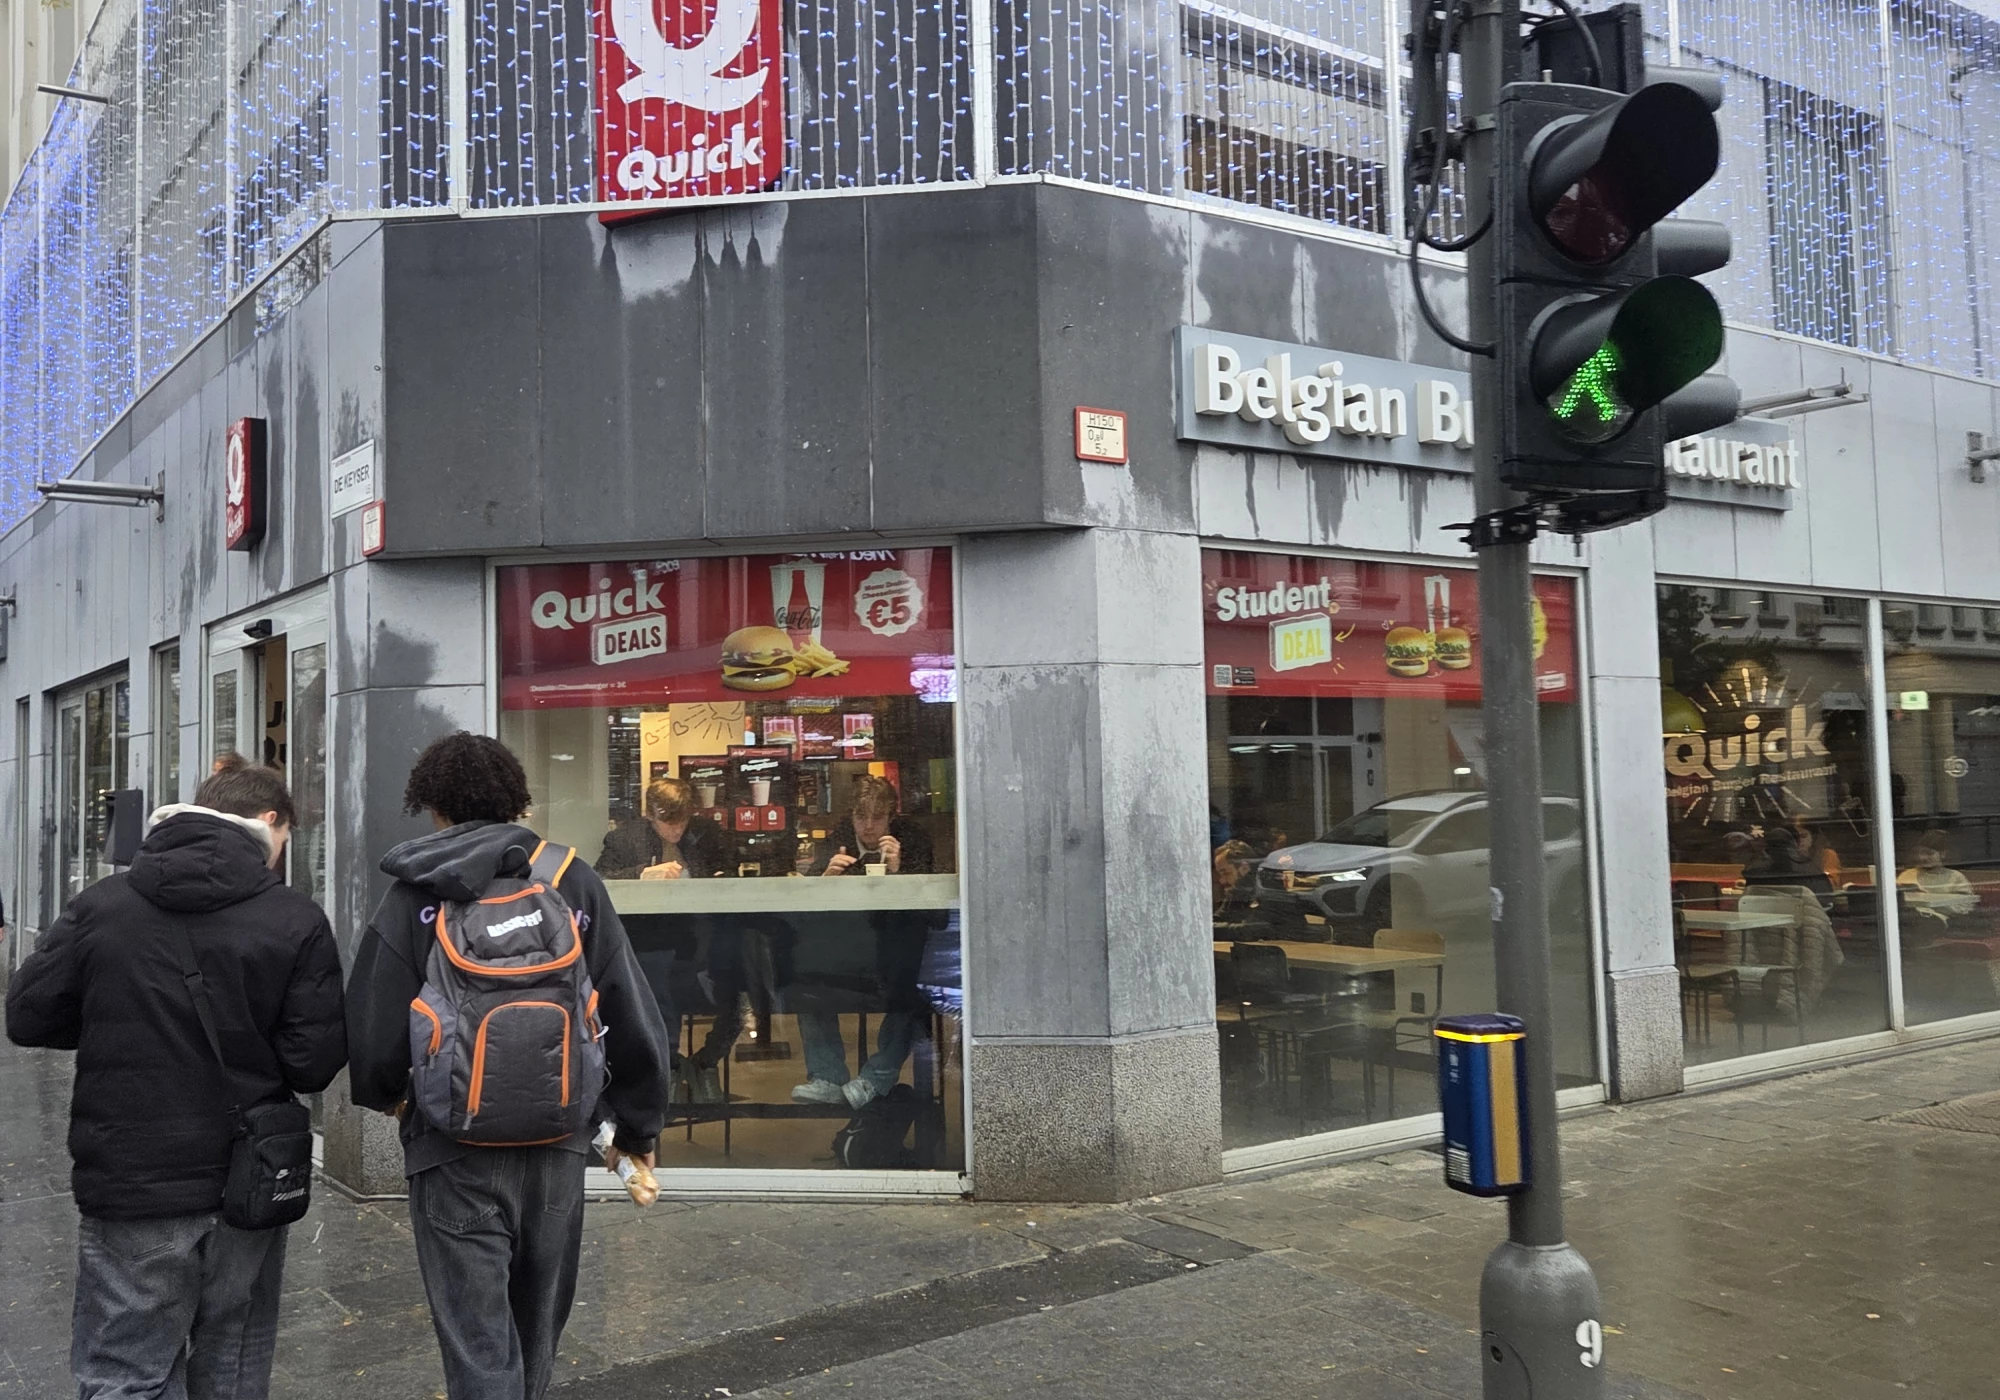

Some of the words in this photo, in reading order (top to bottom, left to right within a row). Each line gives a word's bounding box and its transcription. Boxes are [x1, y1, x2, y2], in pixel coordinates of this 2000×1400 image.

[617, 123, 763, 191] Quick
[1089, 414, 1115, 427] H150
[1196, 342, 1407, 446] Belgian
[1663, 434, 1802, 490] taurant
[334, 477, 344, 495] DE
[344, 464, 371, 489] KEYSER
[531, 568, 667, 631] Quick
[866, 595, 912, 628] €5
[1216, 576, 1332, 621] Student
[604, 625, 662, 657] DEALS
[1283, 628, 1325, 662] DEAL
[1664, 703, 1831, 779] Quick
[1759, 763, 1838, 786] Restaurant
[1575, 1318, 1602, 1368] 9
